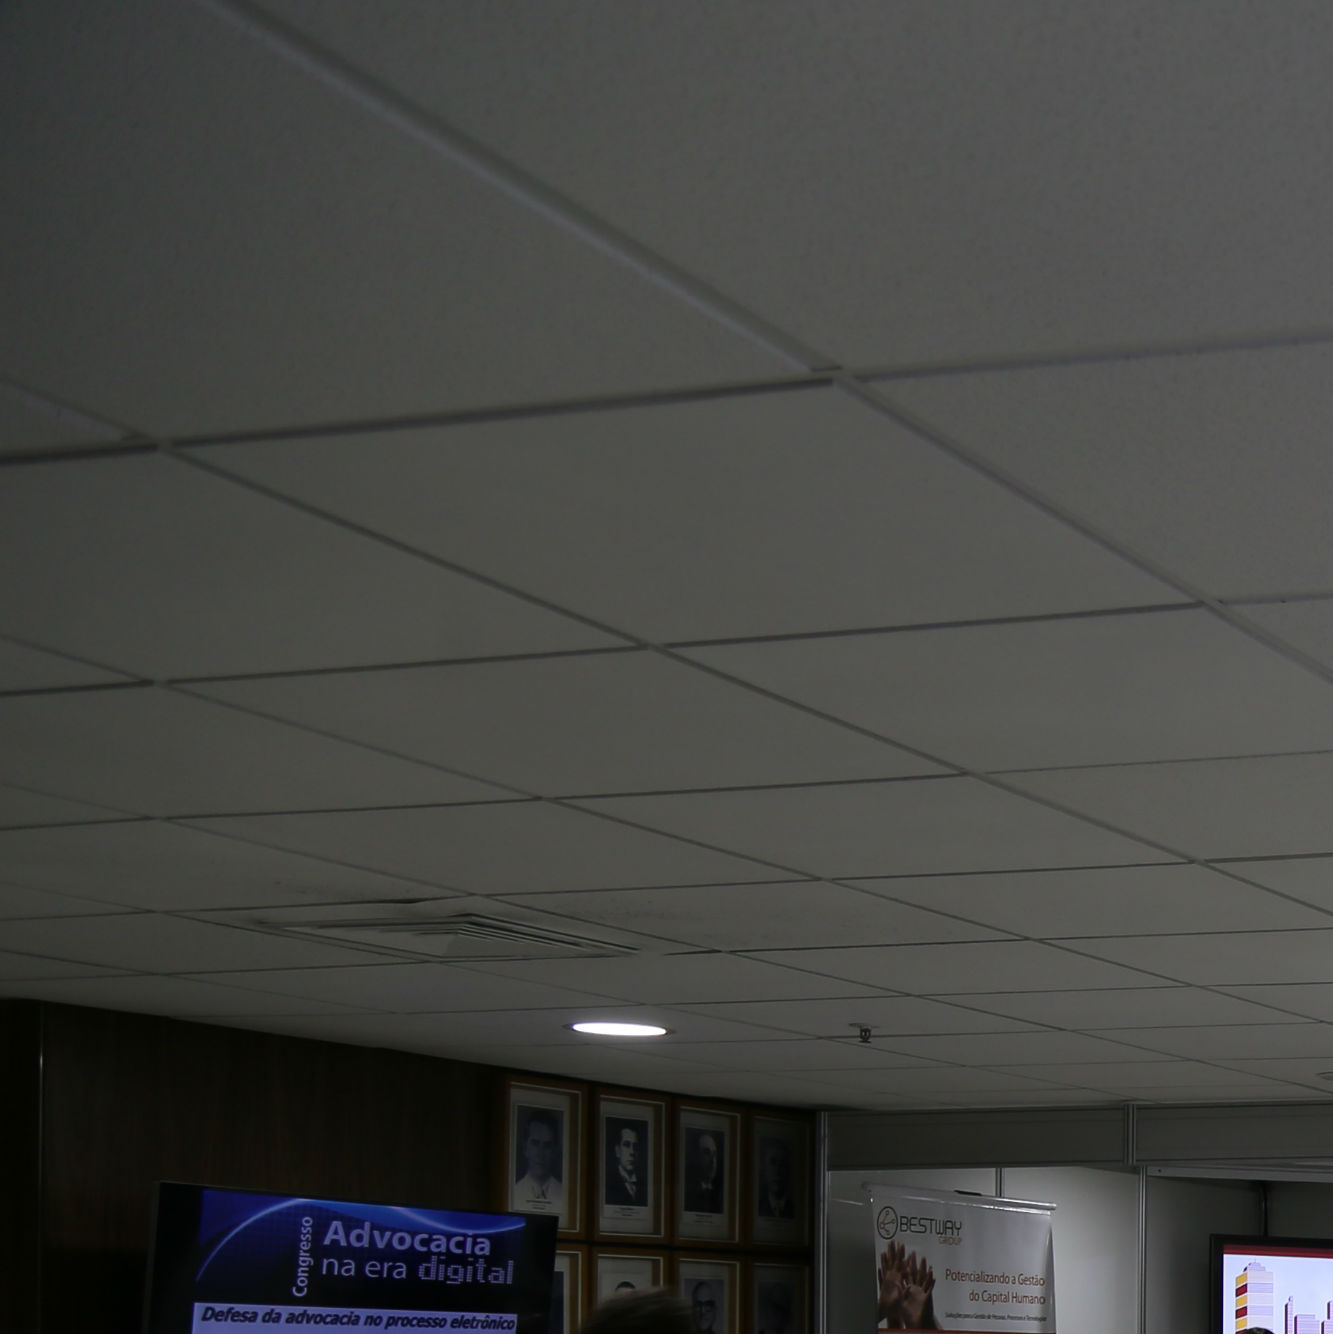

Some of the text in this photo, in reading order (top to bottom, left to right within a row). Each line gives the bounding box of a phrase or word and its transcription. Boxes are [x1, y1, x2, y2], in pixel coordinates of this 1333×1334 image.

[323, 1220, 492, 1256] Advocacia
[900, 1216, 962, 1236] BESTWAY
[292, 1216, 314, 1297] Congresso
[322, 1255, 514, 1285] na era digital
[945, 1268, 1010, 1285] Potencializando
[1018, 1273, 1045, 1287] Gestão
[969, 1290, 1046, 1305] do Capital Humano
[201, 1307, 515, 1331] Defesa da advocacia no processo eletrônico
